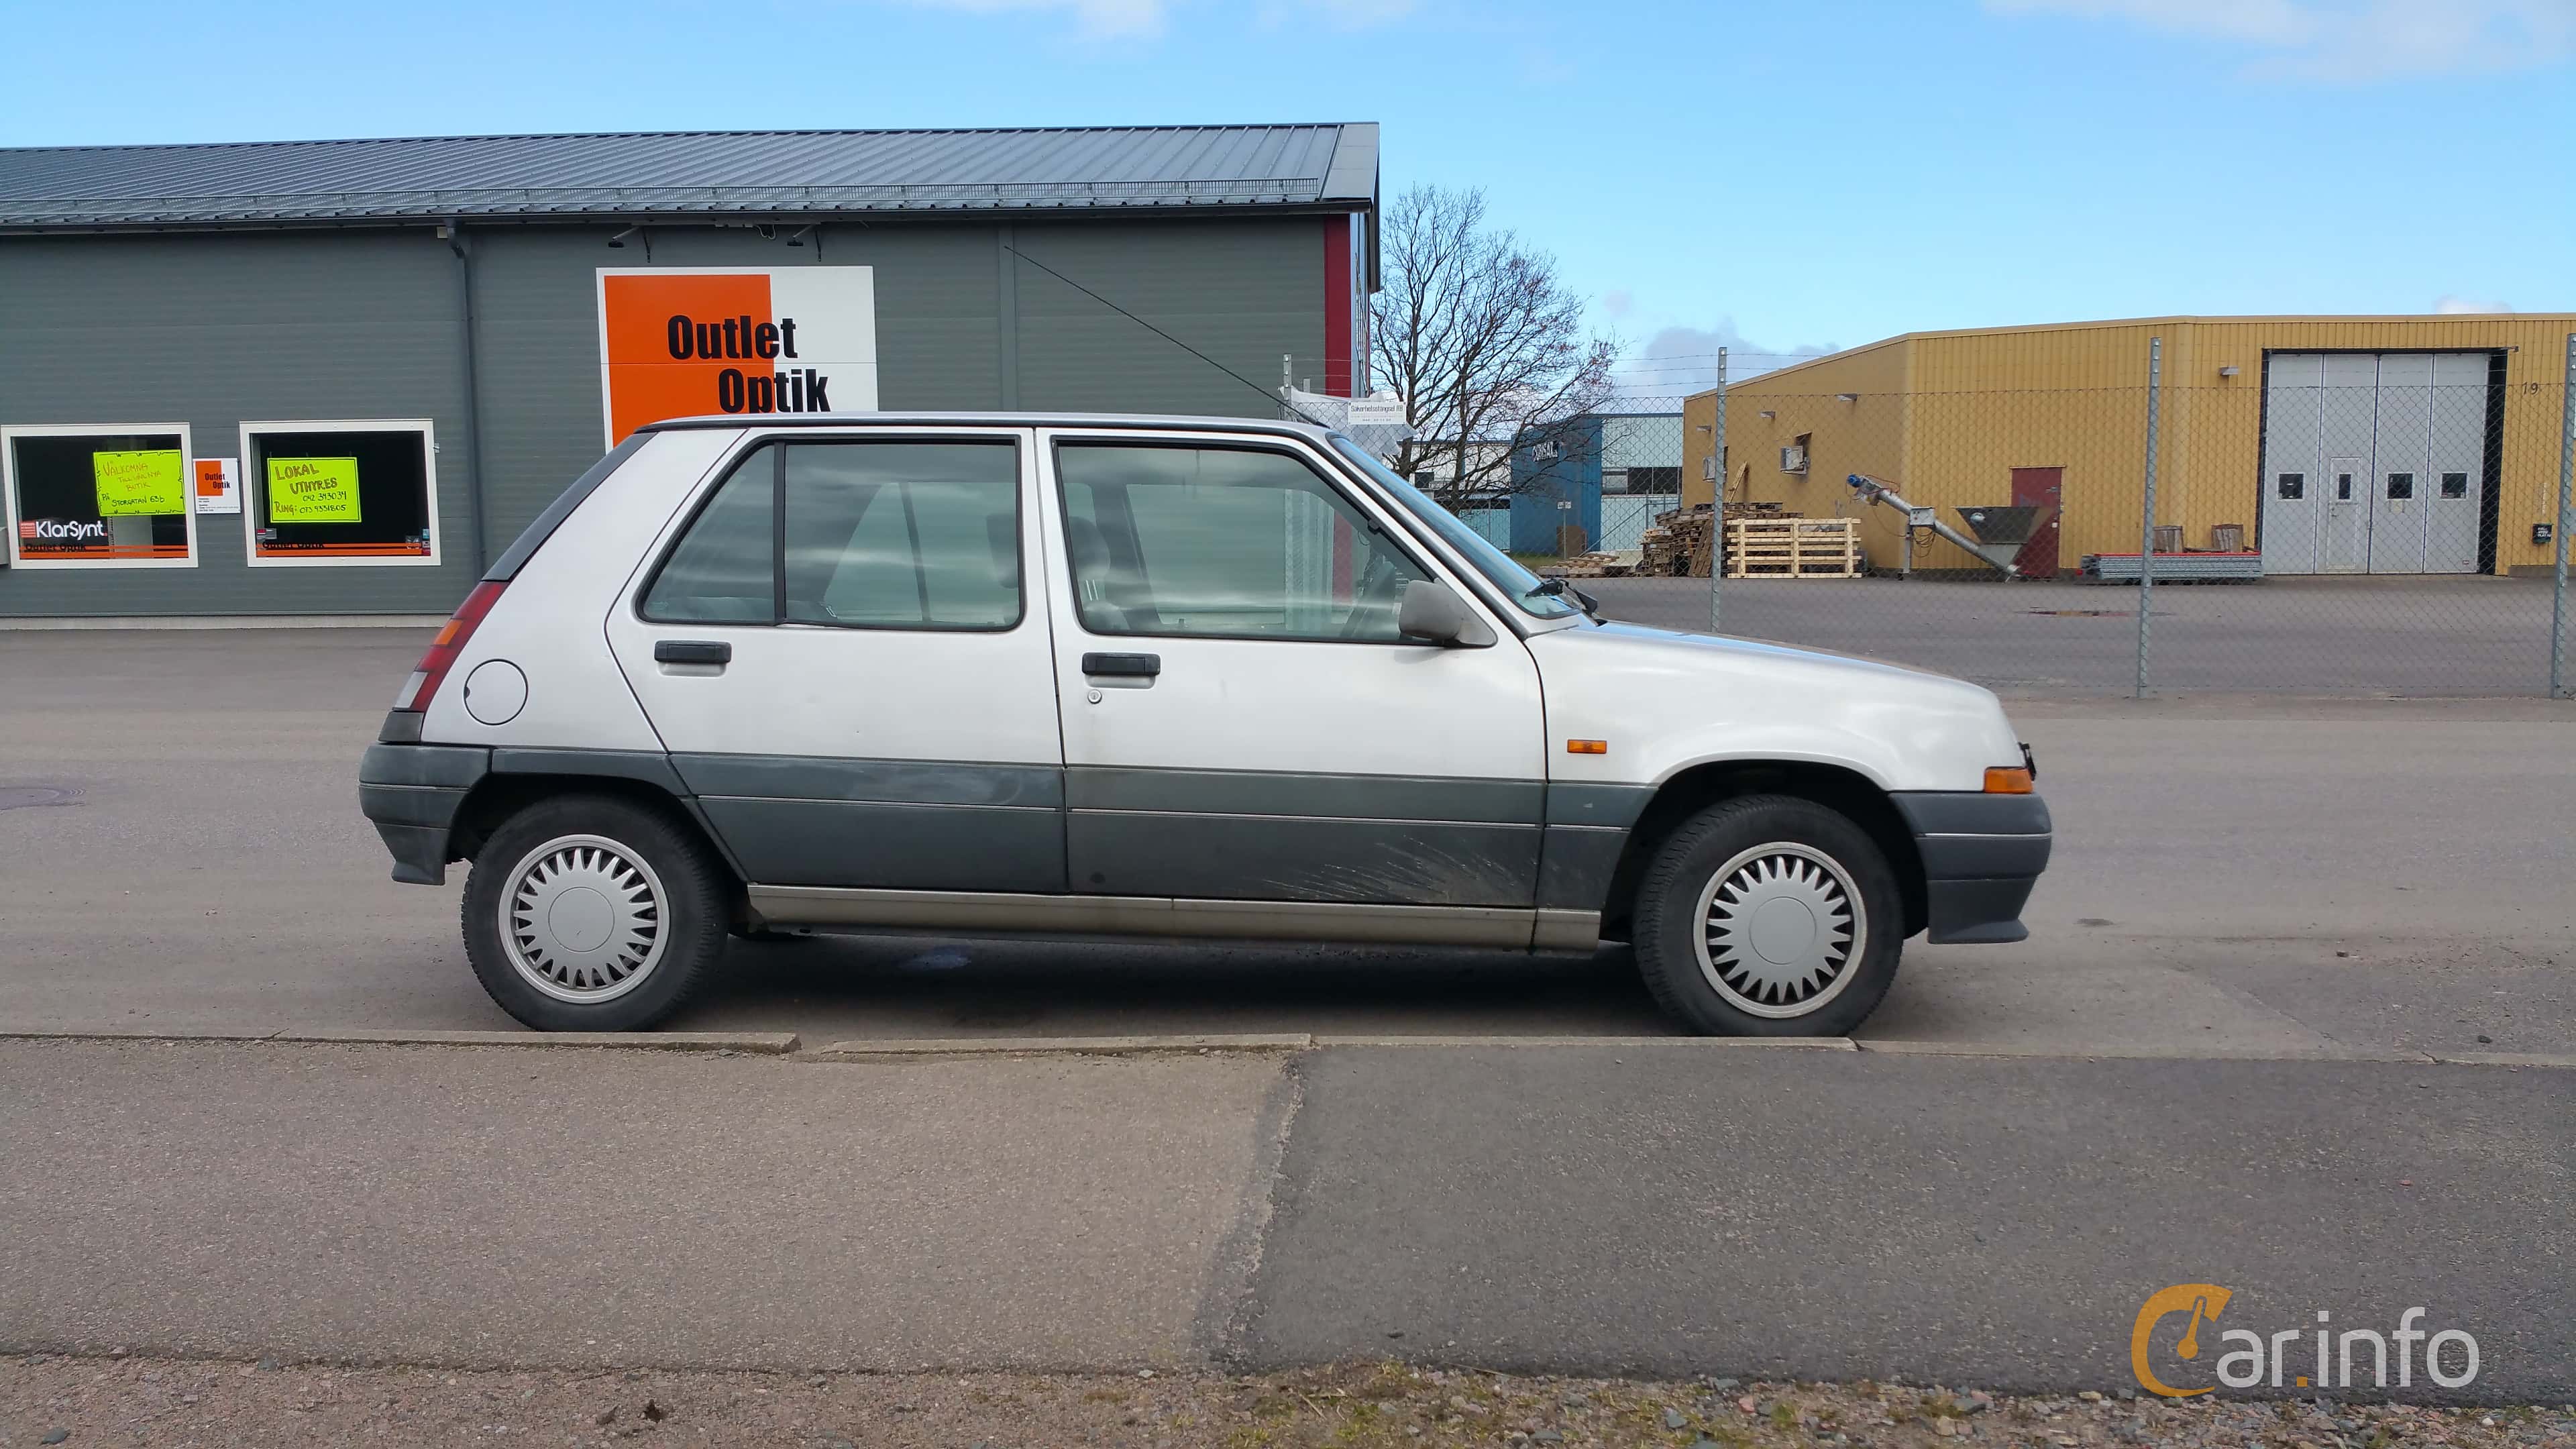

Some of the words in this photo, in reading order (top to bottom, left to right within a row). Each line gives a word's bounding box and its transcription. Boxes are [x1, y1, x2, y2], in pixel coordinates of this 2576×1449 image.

[667, 315, 798, 360] Outlet
[718, 368, 831, 413] Optik
[2522, 382, 2539, 395] 19
[204, 472, 226, 481] Outlet
[274, 464, 320, 480] LOKAL
[212, 480, 231, 490] Optik
[289, 477, 338, 494] UTHYRES
[111, 496, 147, 507] STORGATAN
